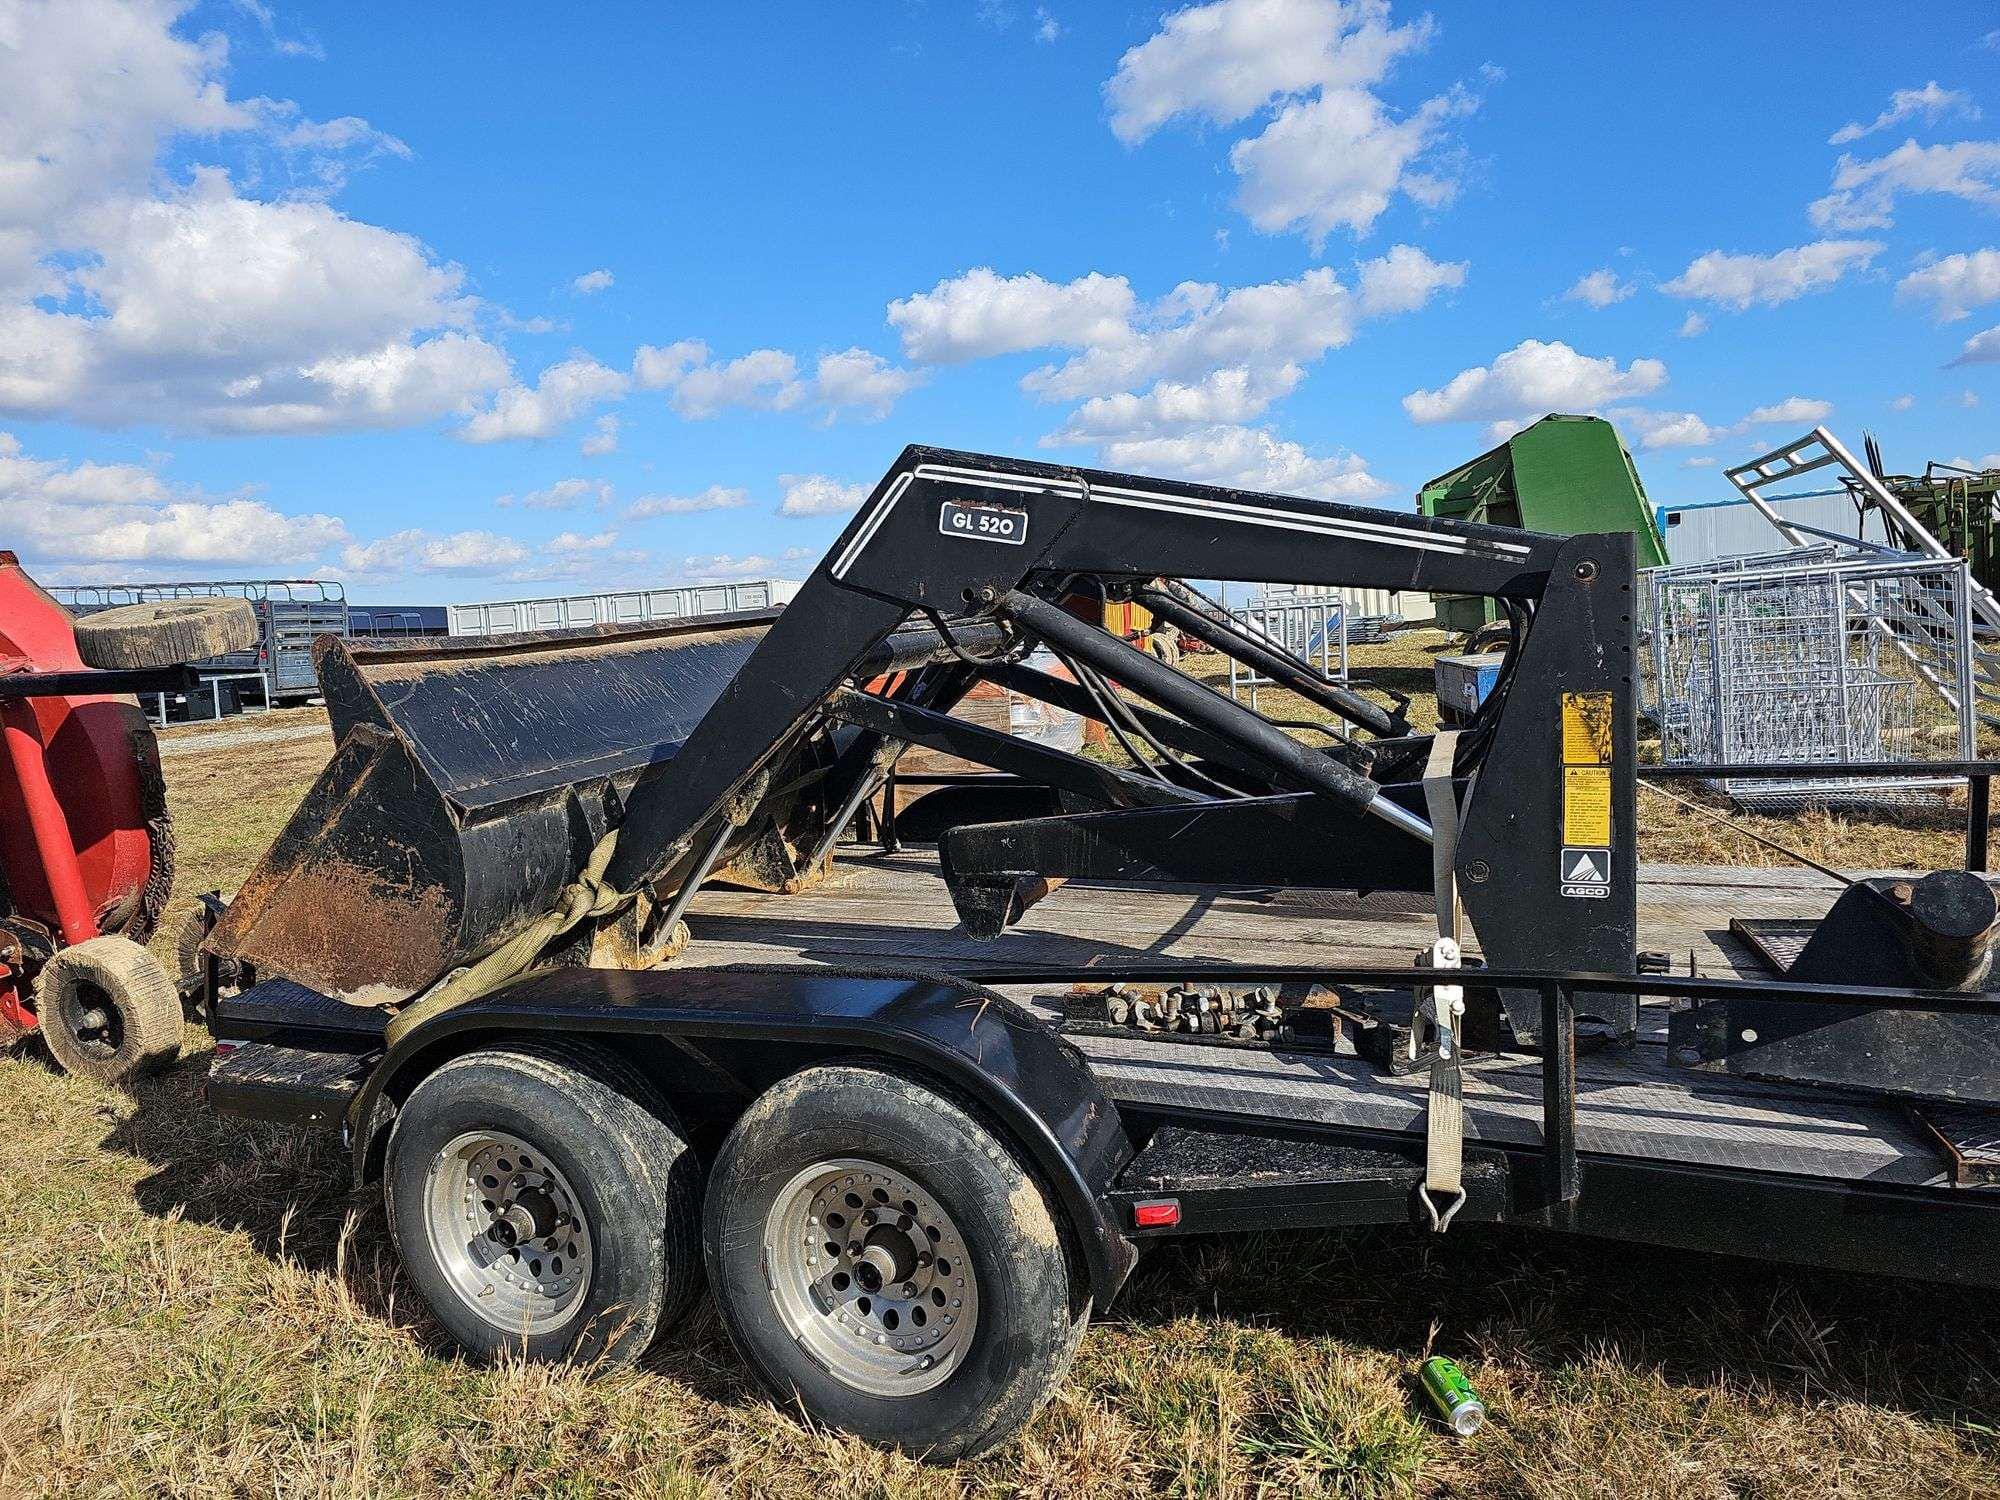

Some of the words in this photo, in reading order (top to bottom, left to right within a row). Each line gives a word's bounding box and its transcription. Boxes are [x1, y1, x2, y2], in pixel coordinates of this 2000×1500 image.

[952, 512, 974, 531] GL
[978, 515, 1014, 535] 520
[1566, 887, 1605, 896] AGCO
